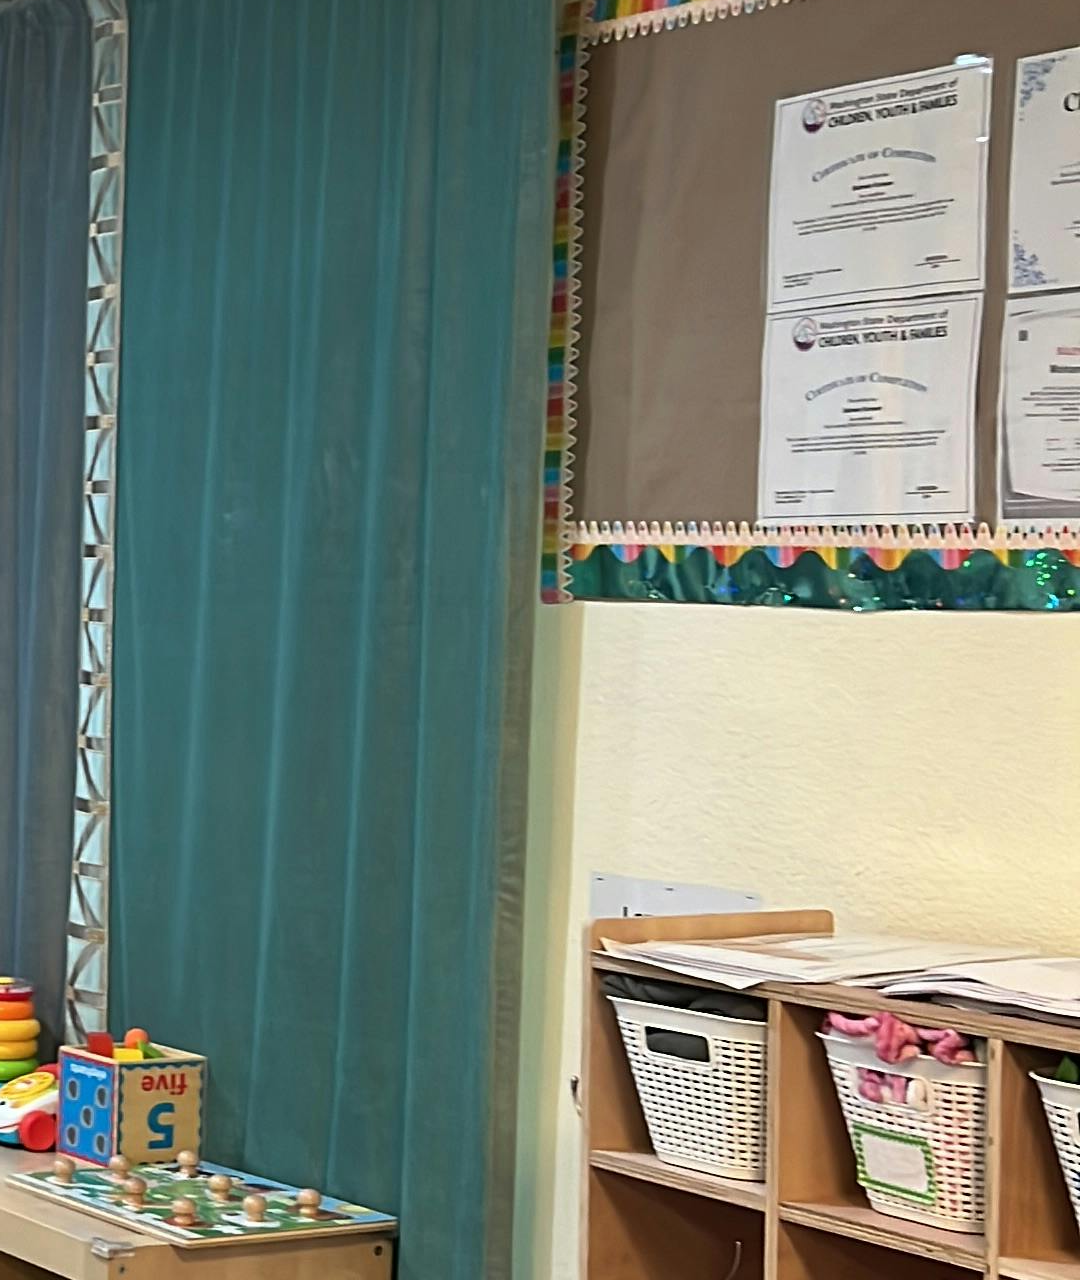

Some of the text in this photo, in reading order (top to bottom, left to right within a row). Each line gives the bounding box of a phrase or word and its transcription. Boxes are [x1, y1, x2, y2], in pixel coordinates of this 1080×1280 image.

[830, 77, 959, 109] Washington State Department of
[875, 104, 909, 119] YOUTH
[911, 102, 918, 114] &
[918, 94, 958, 111] FAMILIES
[820, 309, 949, 330] Washington State Department of
[863, 331, 898, 343] YOUTH
[900, 329, 907, 341] &
[909, 325, 948, 339] FAMILIES
[141, 1073, 188, 1095] five
[147, 1102, 176, 1150] 5
